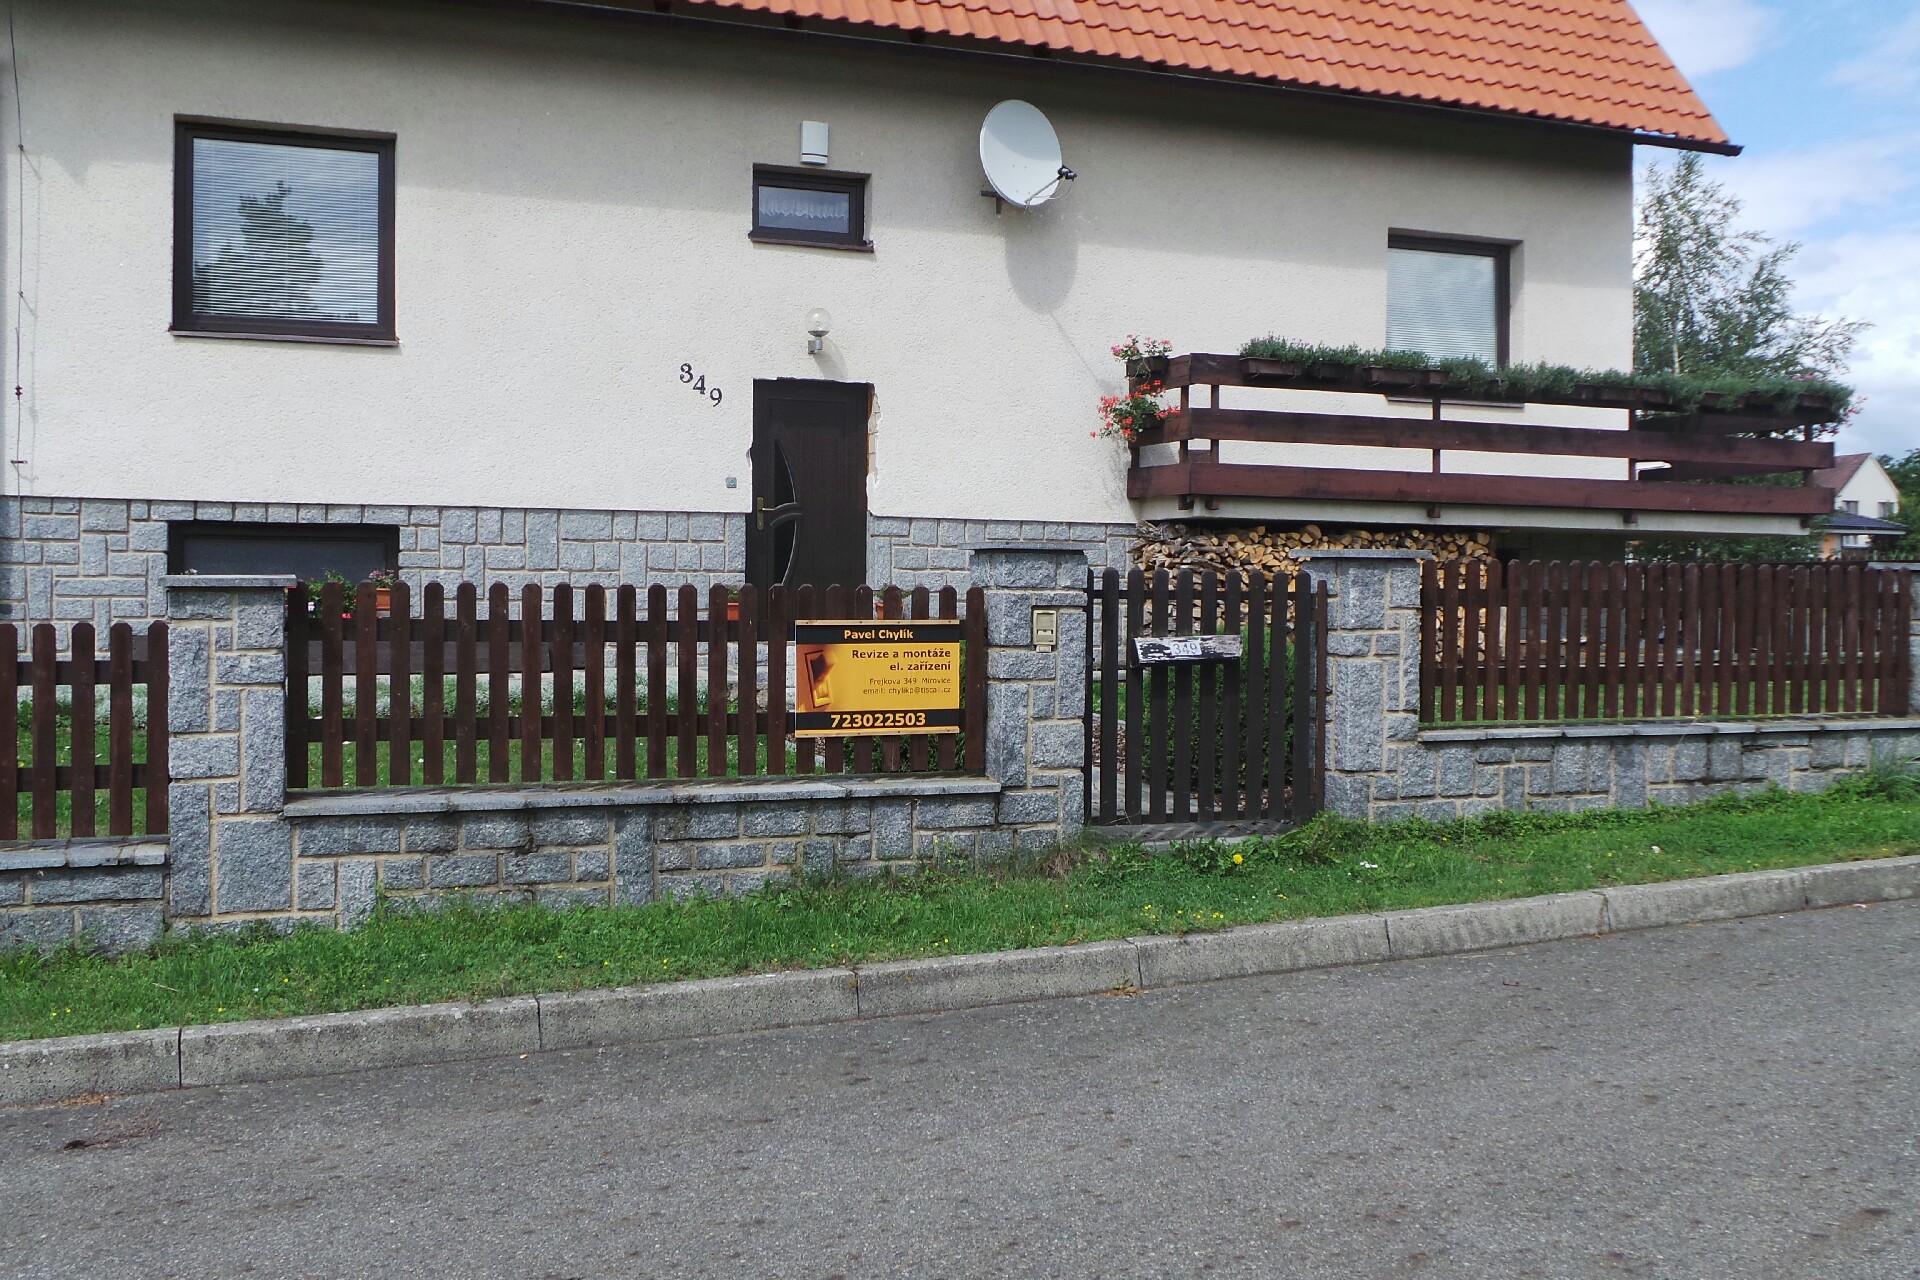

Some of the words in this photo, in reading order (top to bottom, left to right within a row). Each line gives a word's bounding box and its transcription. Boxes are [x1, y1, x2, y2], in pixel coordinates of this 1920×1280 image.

[680, 363, 722, 407] 349
[844, 629, 875, 640] Pavel
[878, 628, 914, 641] Chylík
[852, 649, 889, 659] Revize
[903, 648, 951, 659] montáže
[1173, 643, 1197, 654] 349
[890, 662, 904, 671] el.
[907, 660, 951, 671] zařízení
[903, 677, 917, 685] 349
[863, 687, 886, 695] email:
[830, 712, 926, 728] 723022503
